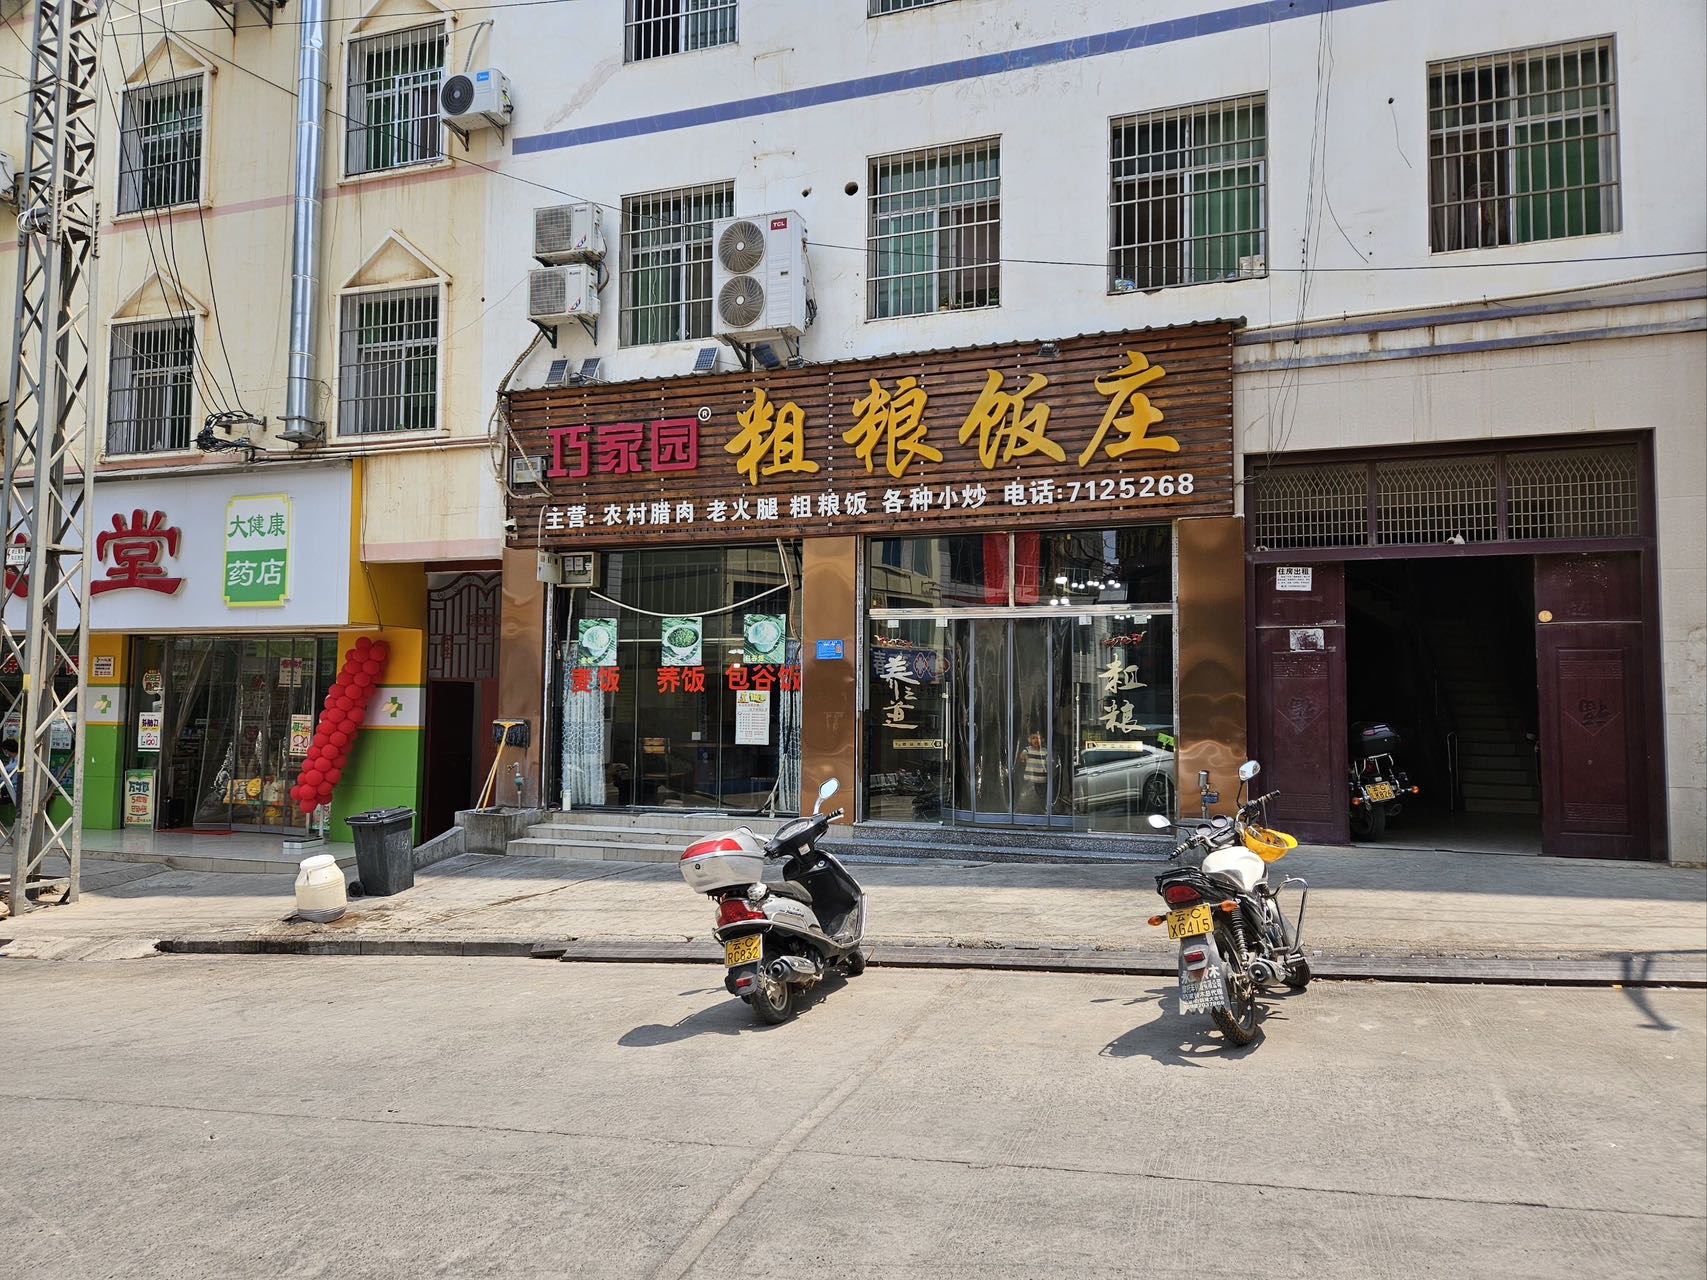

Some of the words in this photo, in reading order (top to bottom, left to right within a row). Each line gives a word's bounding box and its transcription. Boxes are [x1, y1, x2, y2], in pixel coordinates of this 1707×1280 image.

[724, 350, 1180, 486] 粗粮饭庄
[546, 417, 699, 478] 巧家园
[602, 500, 694, 526] 农村腊肉
[707, 497, 778, 522] 老火腿
[790, 491, 868, 519] 粗粮饭
[882, 483, 987, 514] 各种小炒
[227, 512, 286, 538] 大健康
[227, 558, 285, 586] 药店
[725, 663, 801, 692] 包谷饭
